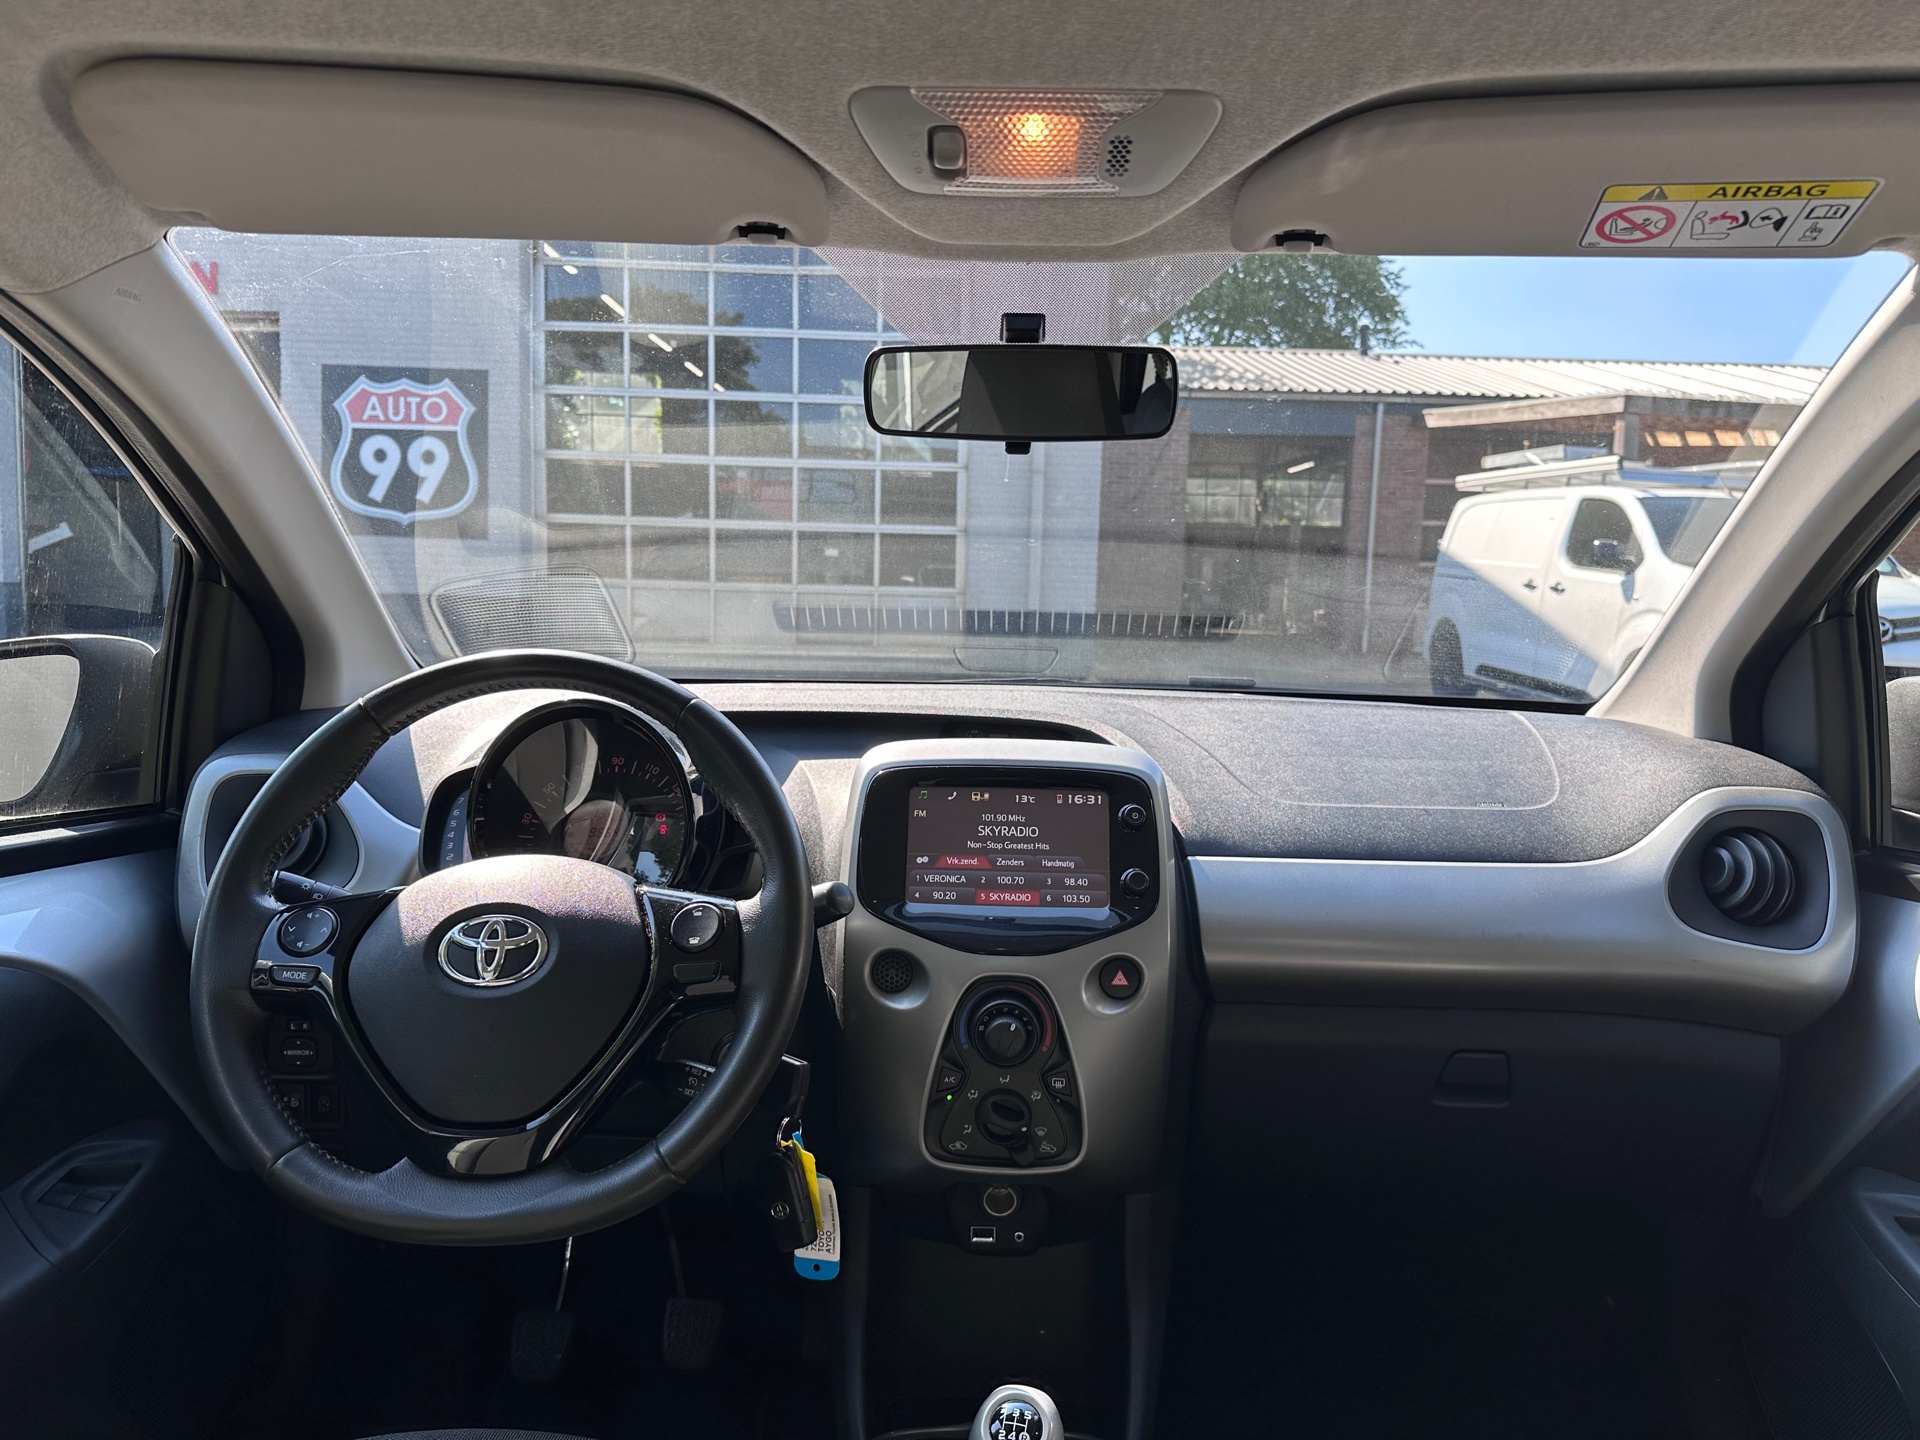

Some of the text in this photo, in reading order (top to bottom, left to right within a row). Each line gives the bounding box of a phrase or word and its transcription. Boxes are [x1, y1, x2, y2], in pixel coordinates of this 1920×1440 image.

[1706, 184, 1831, 199] AIRBAG
[361, 395, 448, 423] AUTO
[358, 434, 450, 504] 99
[611, 757, 625, 766] 90
[645, 763, 660, 775] 110
[542, 782, 556, 795] 50
[1067, 794, 1102, 805] 16:31
[914, 809, 927, 818] FM
[981, 813, 1026, 823] 101.90 MHz
[449, 820, 458, 828] 5
[977, 825, 1039, 838] SKYRADIO
[446, 842, 454, 850] 3
[967, 840, 1050, 851] Non-Stop Greatest Hits
[446, 853, 454, 861] 2
[946, 856, 980, 866] Vrk.zend.
[996, 857, 1025, 867] Zenders
[1042, 859, 1075, 868] Handmatig
[923, 874, 967, 883] VERONICA
[981, 876, 1025, 885] 2 100.70
[1046, 877, 1089, 887] 3 98.40
[914, 891, 957, 900] 4 90.20
[989, 892, 1032, 902] SKYRADIO
[1046, 894, 1091, 903] 6 103.50
[282, 970, 307, 980] MODE
[691, 1067, 703, 1077] RES
[683, 1087, 696, 1096] SET
[1012, 1408, 1020, 1417] 3
[1024, 1410, 1032, 1420] 5
[998, 1430, 1006, 1440] 2
[1008, 1431, 1016, 1440] 4
